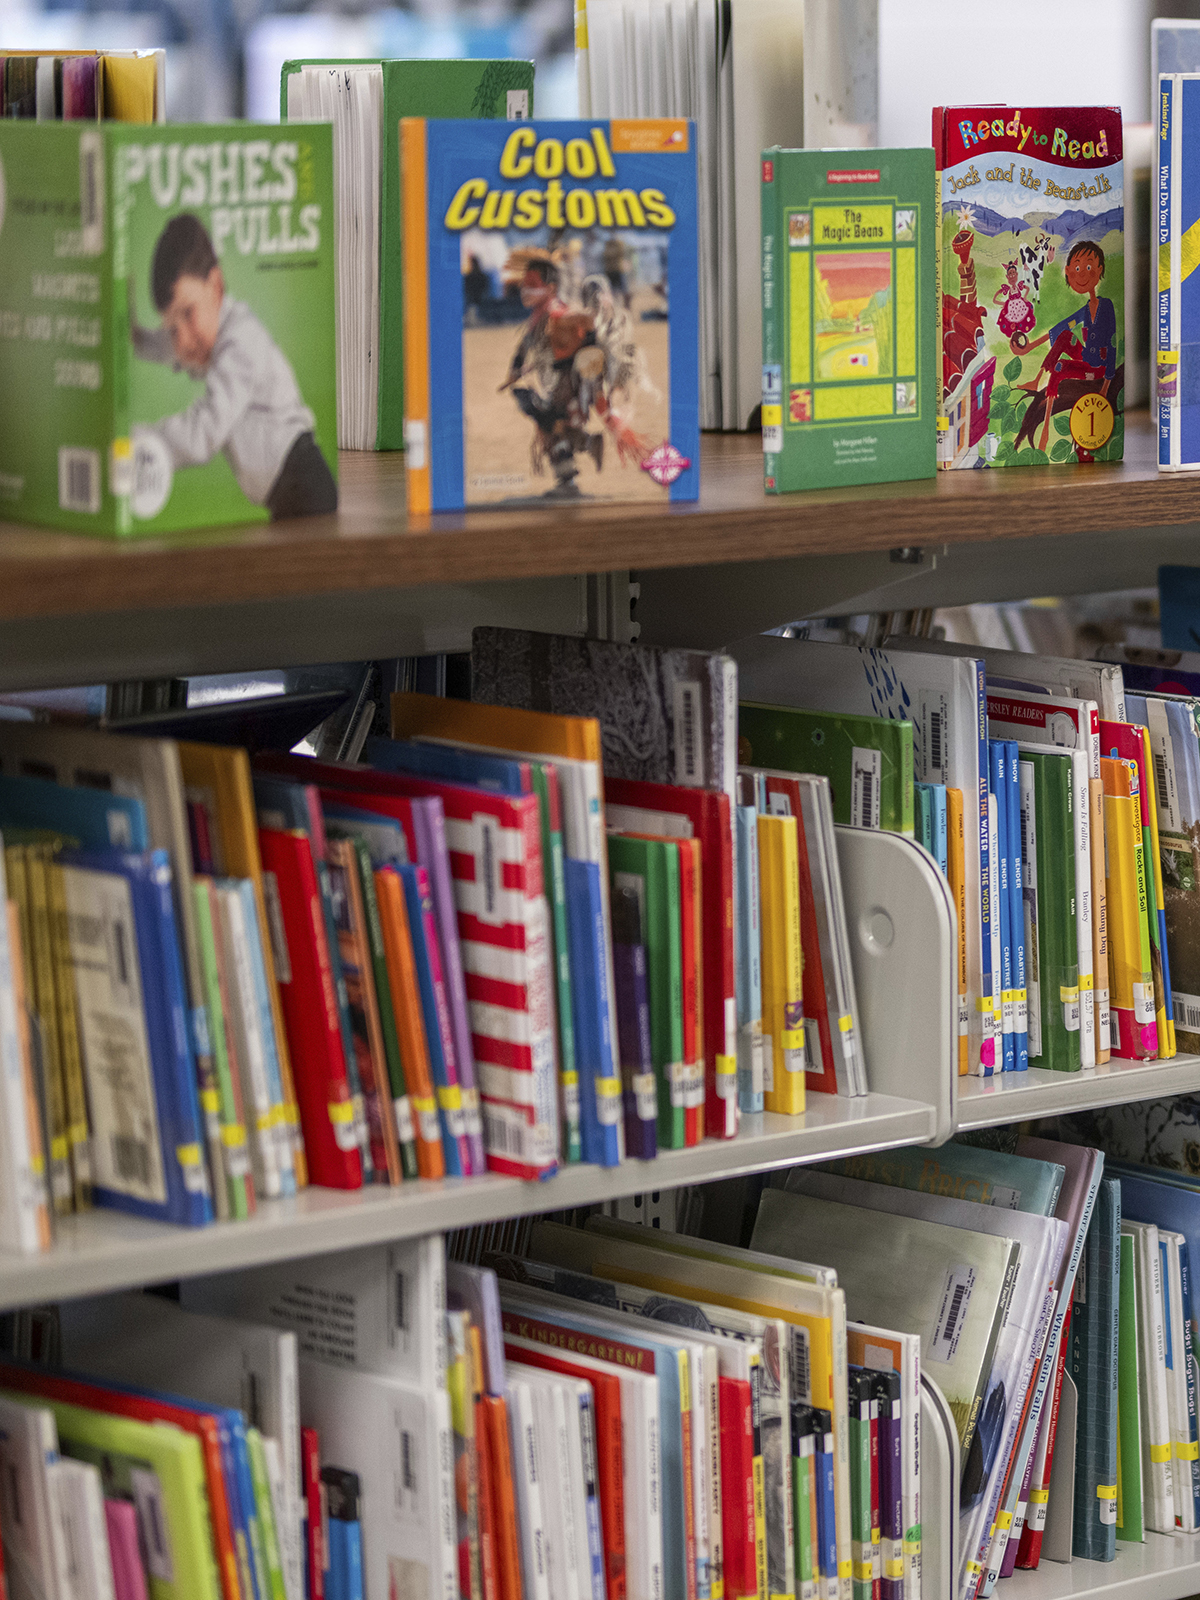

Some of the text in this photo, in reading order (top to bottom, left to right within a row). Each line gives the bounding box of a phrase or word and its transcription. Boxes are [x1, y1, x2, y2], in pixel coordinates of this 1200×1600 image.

[1161, 92, 1170, 140] Jenkins/Page
[958, 110, 1109, 160] Ready to Read
[500, 127, 616, 179] Cool
[124, 140, 299, 208] PUSHES
[947, 163, 1112, 200] Jack and the Beanstalk
[1160, 165, 1169, 190] What
[445, 178, 677, 230] Customs
[1160, 192, 1168, 205] Do
[211, 204, 322, 255] PULLS
[843, 209, 862, 223] The
[1160, 208, 1169, 226] You
[822, 225, 884, 241] Magic Beans
[1160, 228, 1168, 243] Do
[1160, 294, 1169, 316] With
[1160, 326, 1169, 344] Tail
[1076, 397, 1109, 413] Level
[1087, 411, 1096, 437] 1
[980, 798, 988, 816] THE
[1132, 796, 1141, 843] Investigate
[980, 820, 989, 851] WATER
[1135, 848, 1143, 874] Rocks
[982, 892, 990, 924] WORLD
[1081, 891, 1090, 923] Branley
[1138, 895, 1146, 913] Soil
[1099, 894, 1108, 956] A Rainy Day
[1003, 946, 1011, 988] CRABTREE
[1017, 945, 1025, 988] CRABTREE
[1069, 1184, 1096, 1273] STEWART BERGUM
[517, 1321, 645, 1370] KINDERGARTEN!
[1156, 1325, 1164, 1361] GIBBONS
[1183, 1320, 1192, 1349] Bugs!
[1028, 1312, 1065, 1422] When Rain Falls
[1056, 1356, 1066, 1371] Judy
[1185, 1353, 1194, 1384] Bugs!
[1055, 1372, 1063, 1388] Allen
[969, 1395, 983, 1421] Animals
[1051, 1399, 1060, 1419] Tudor
[1187, 1386, 1196, 1417] Bugs!
[962, 1433, 973, 1449] Too!
[1045, 1421, 1057, 1455] Humphries
